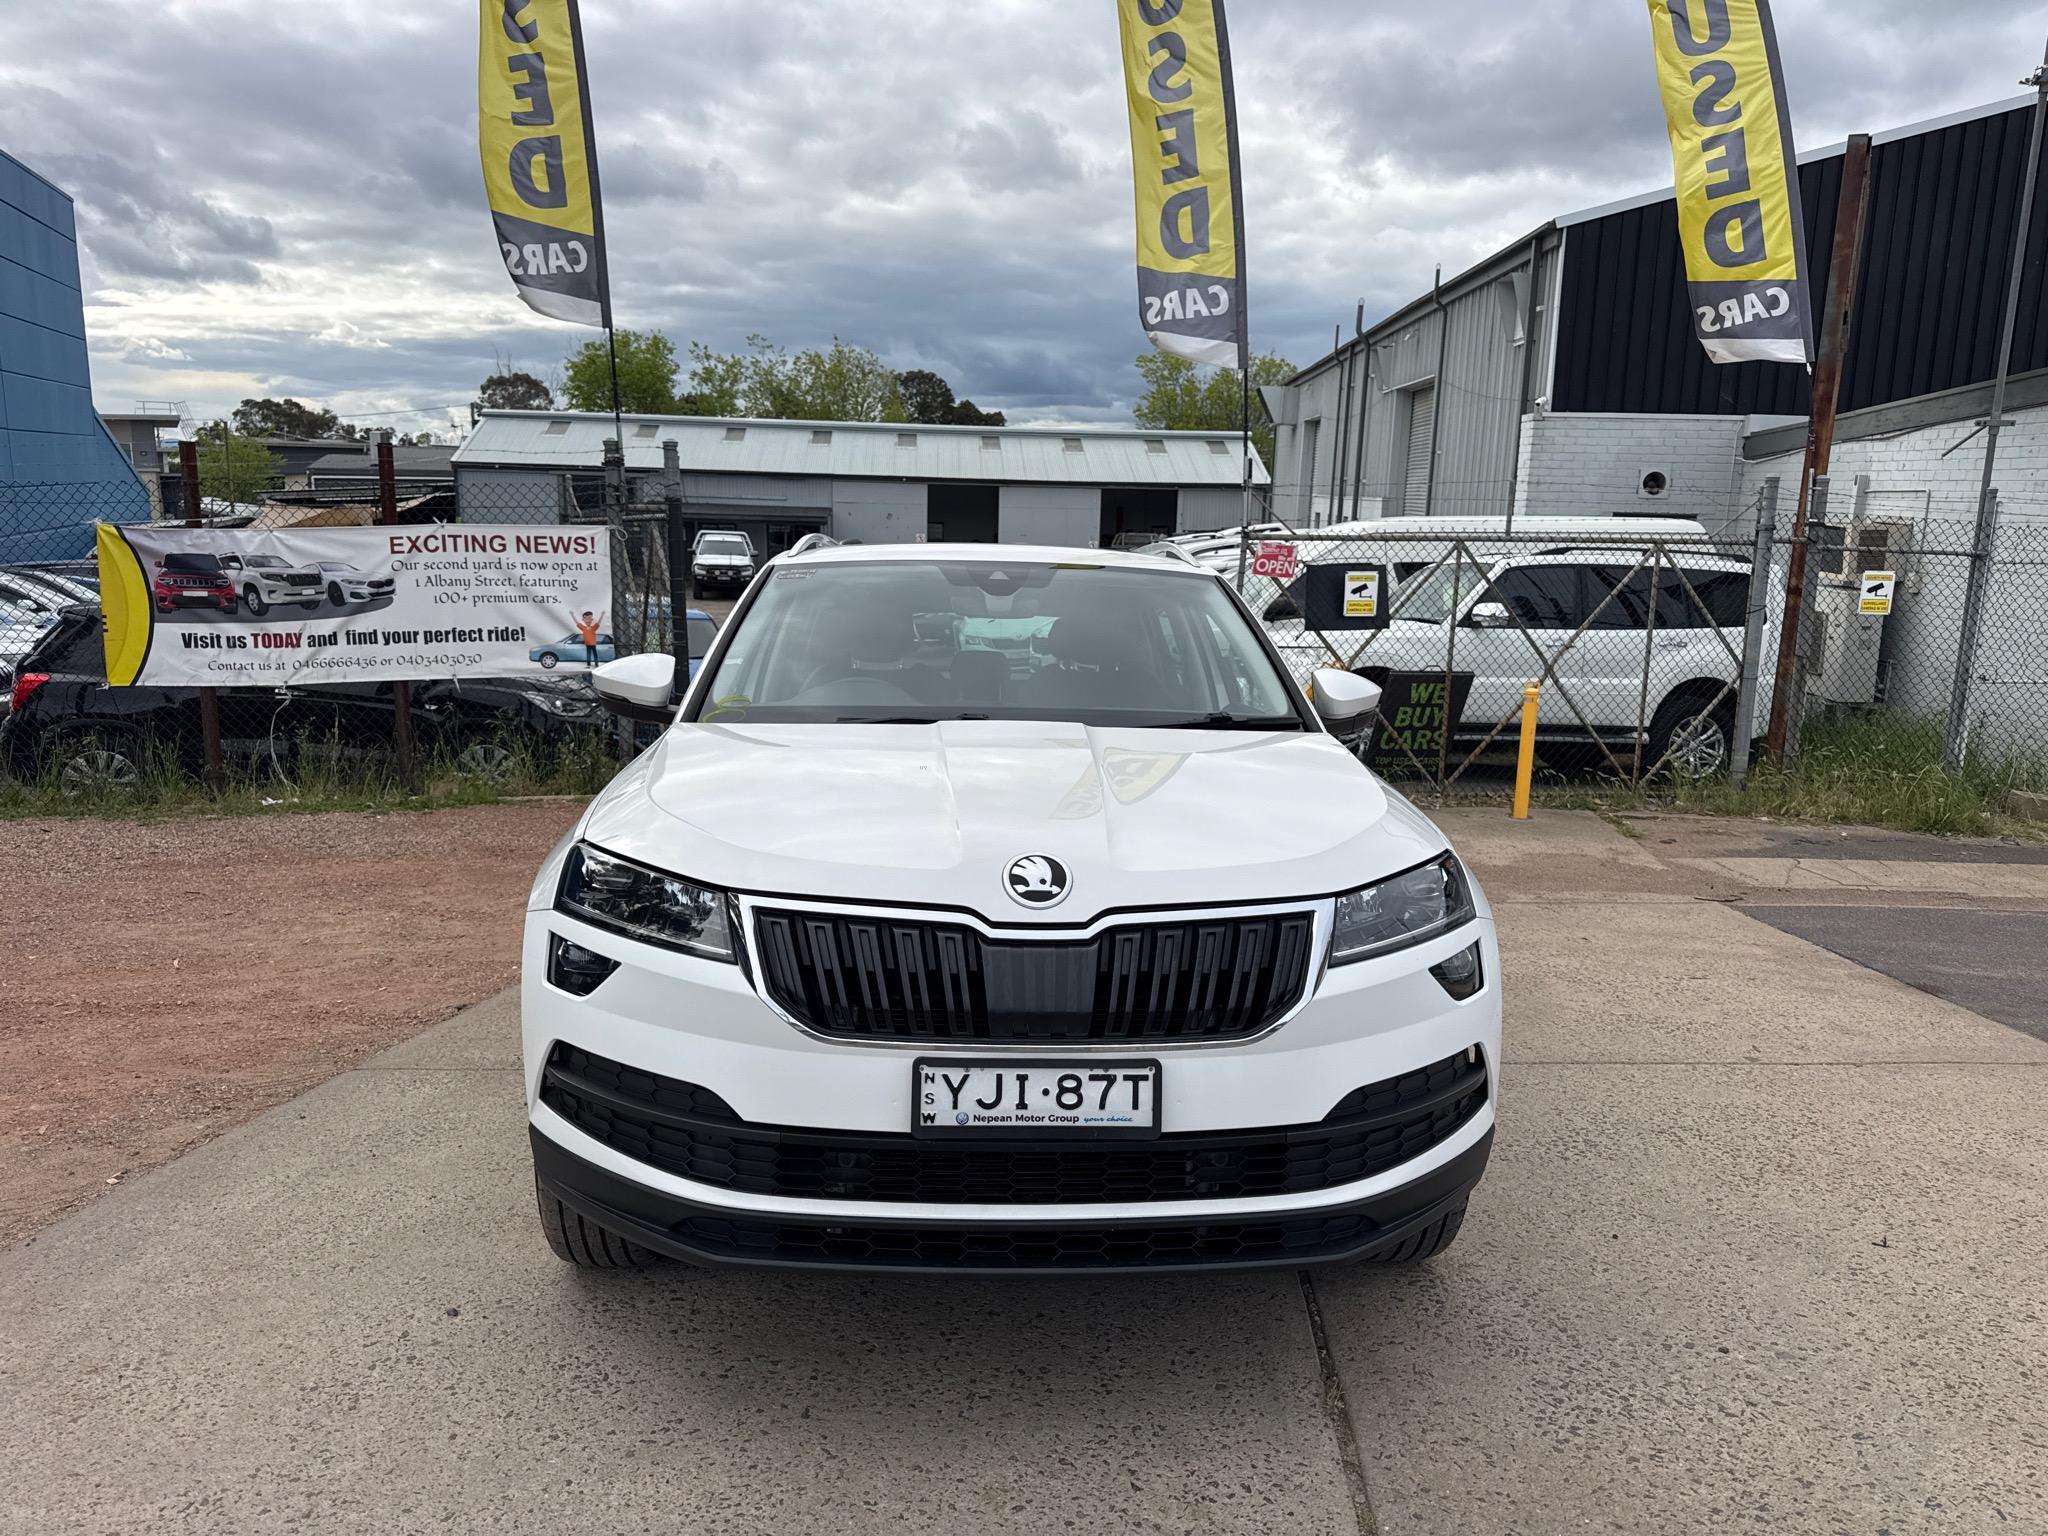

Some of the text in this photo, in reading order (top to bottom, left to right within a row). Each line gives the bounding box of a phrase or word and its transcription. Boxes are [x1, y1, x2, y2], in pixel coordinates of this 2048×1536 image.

[389, 534, 595, 554] EXCITING NEWS!
[391, 557, 598, 574] Our second yard is now open at
[1256, 558, 1295, 574] OPEN
[424, 574, 471, 591] Albany
[474, 575, 516, 587] Street,
[519, 573, 579, 591] featuring
[434, 590, 562, 607] 100+ premium cars.
[181, 626, 526, 649] Visit us TODAY and find your perfect ride!
[208, 660, 254, 671] Contact
[258, 662, 272, 671] us
[275, 662, 286, 671] at
[292, 656, 377, 670] 0466666436
[396, 653, 482, 667] 0403403030
[1411, 683, 1446, 704] WE
[1395, 707, 1445, 727] BUY
[1380, 730, 1444, 750] CARS
[973, 1114, 1012, 1123] Nepean
[1015, 1114, 1046, 1122] Motor
[1048, 1115, 1080, 1124] Group
